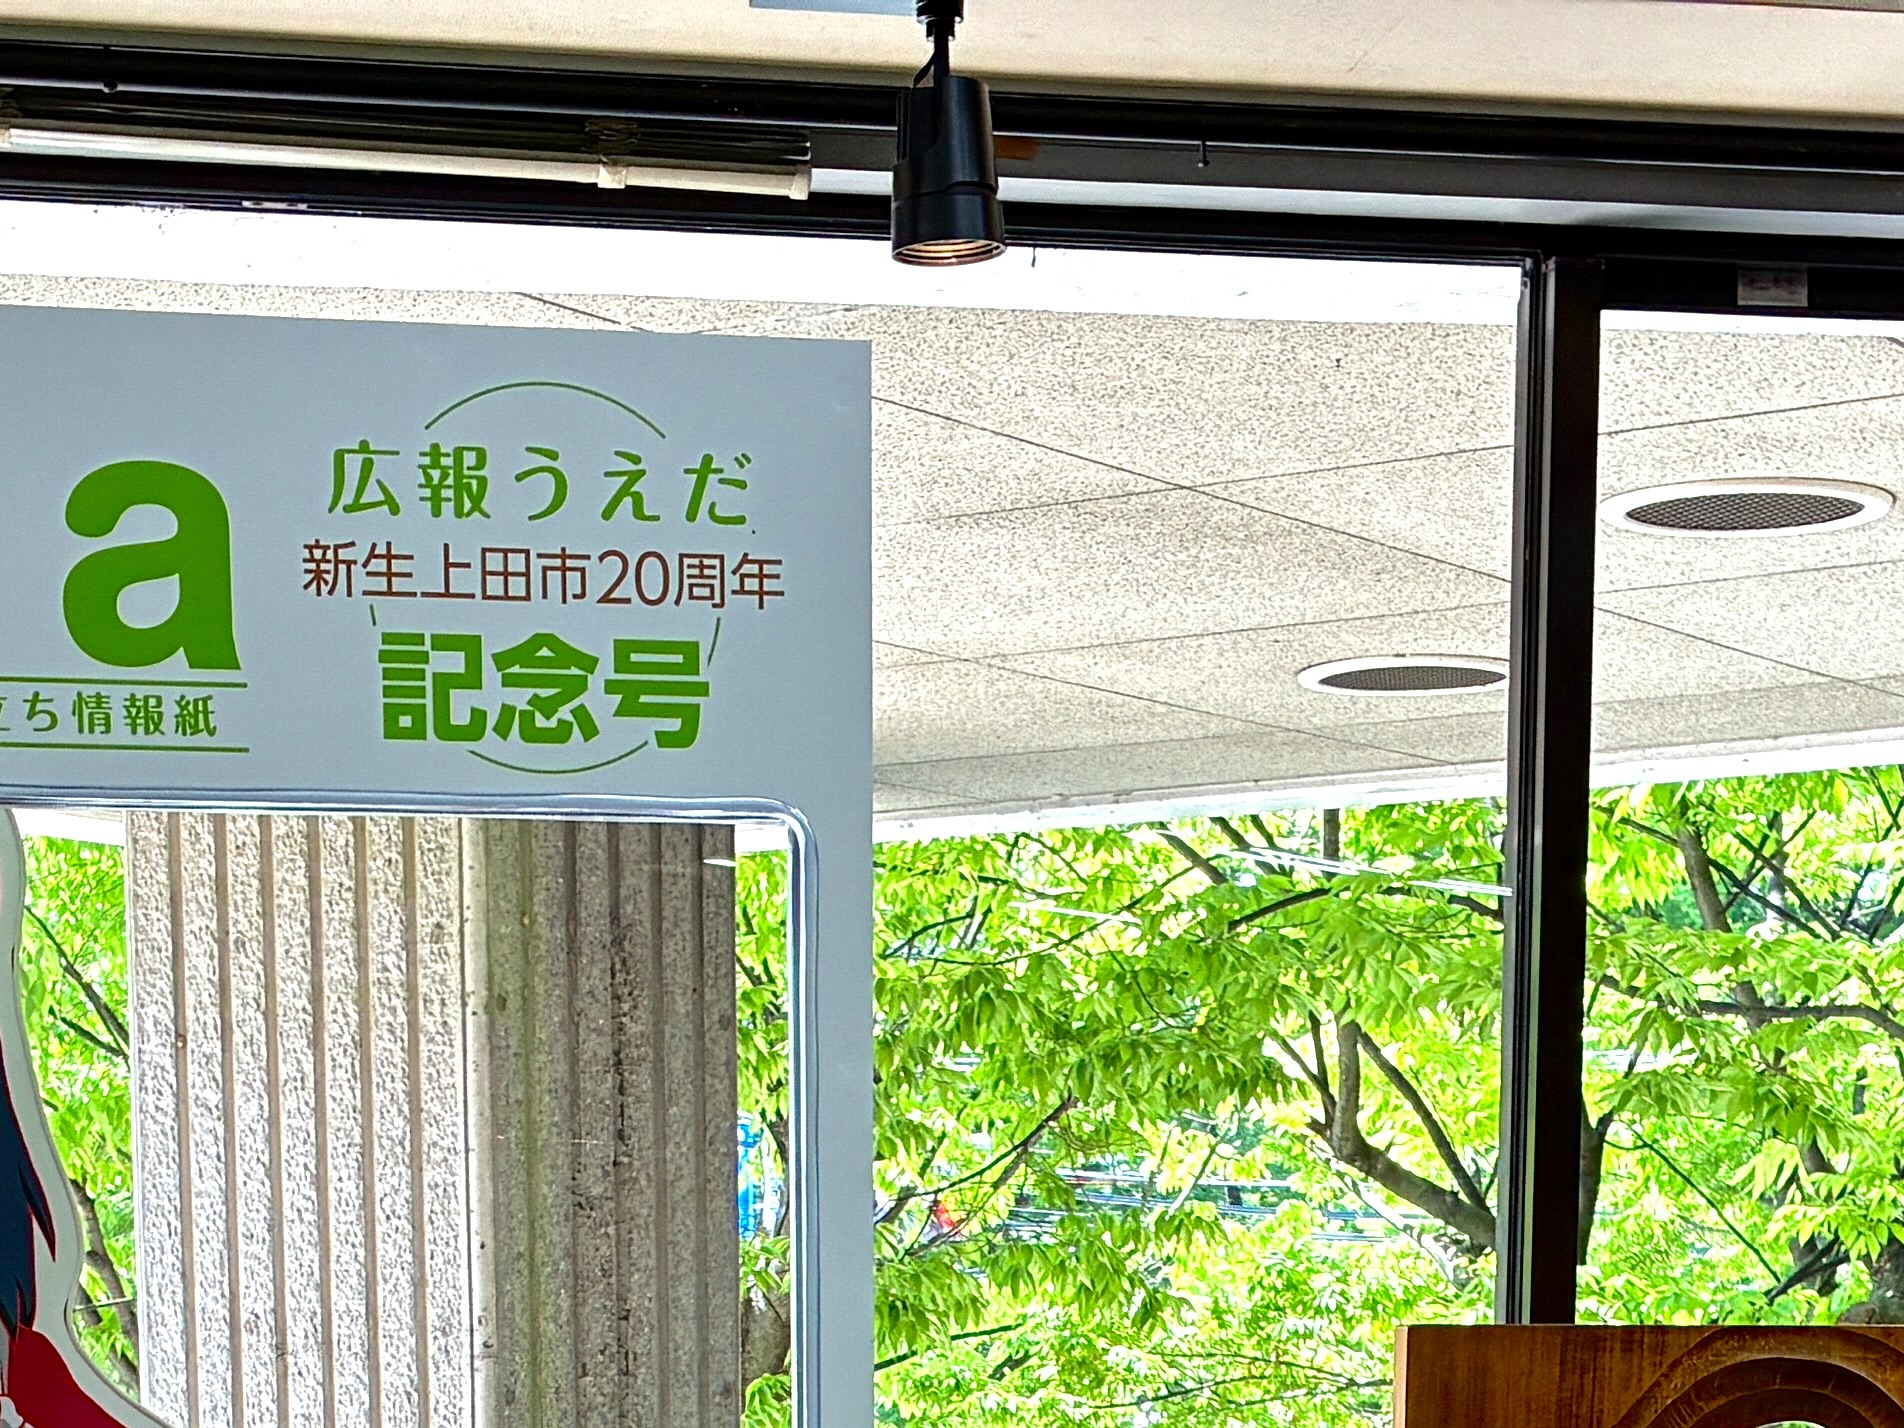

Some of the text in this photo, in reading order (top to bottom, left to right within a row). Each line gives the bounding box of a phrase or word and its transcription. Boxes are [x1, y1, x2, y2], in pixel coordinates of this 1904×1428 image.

[328, 439, 752, 526] 広報うえだ
[301, 538, 786, 610] 新生上田市20周年
[378, 632, 710, 750] 記念号
